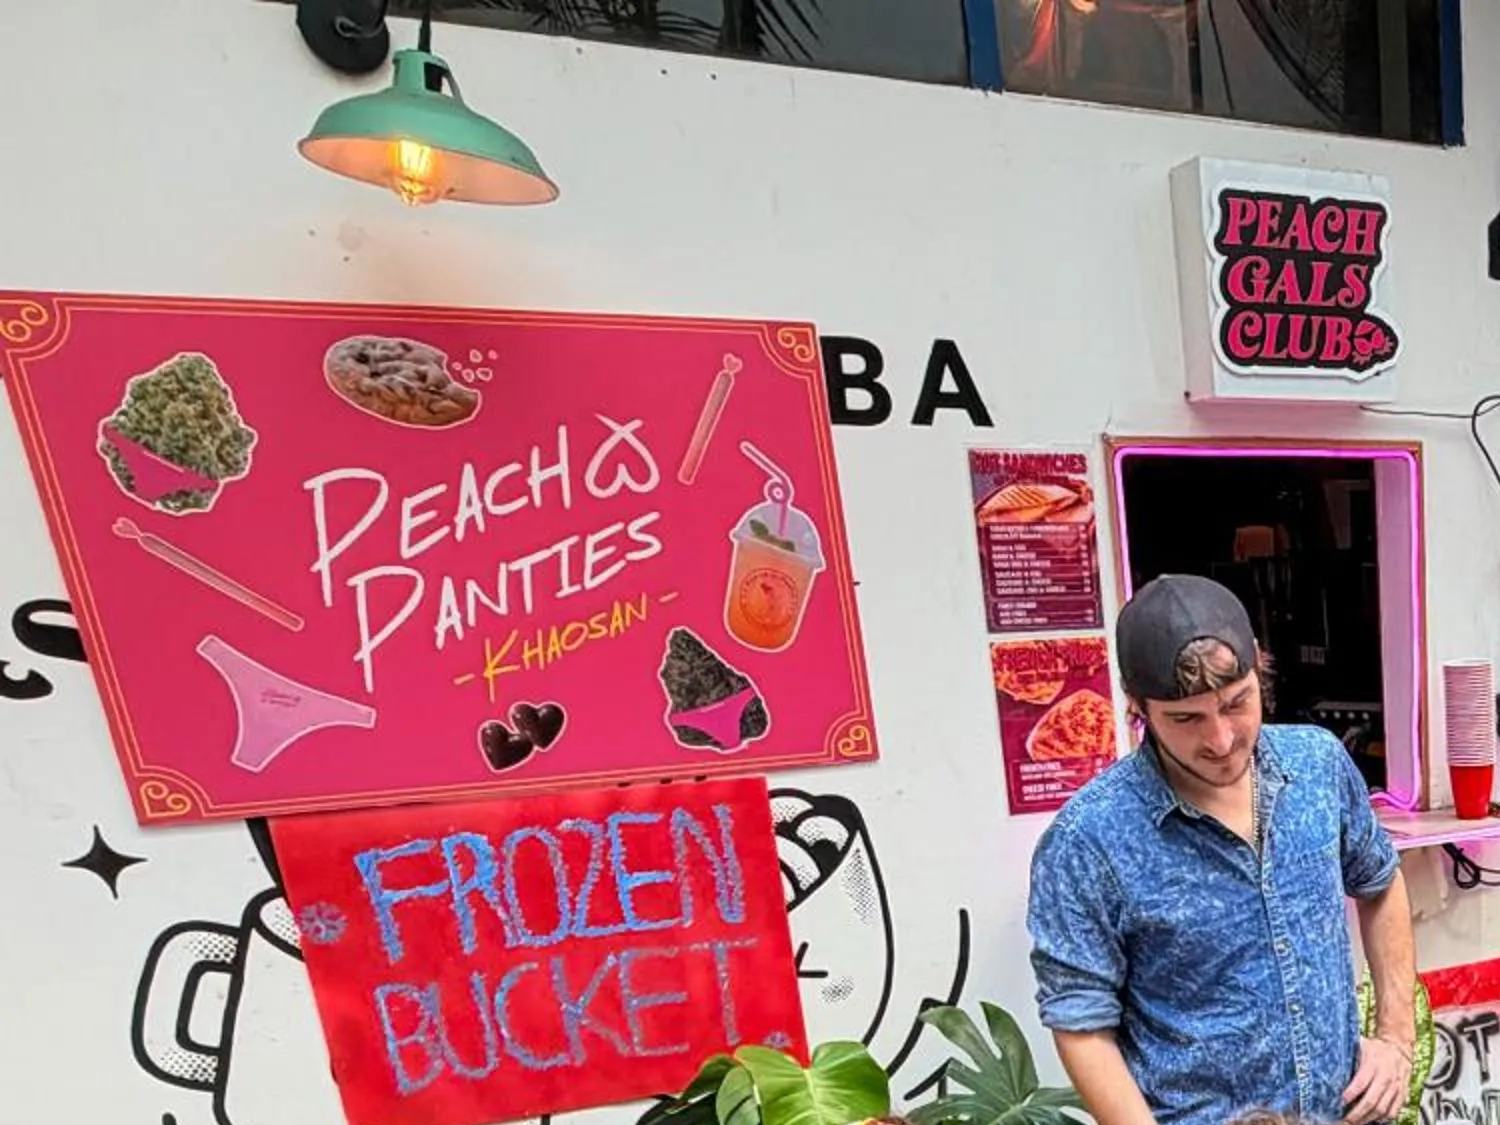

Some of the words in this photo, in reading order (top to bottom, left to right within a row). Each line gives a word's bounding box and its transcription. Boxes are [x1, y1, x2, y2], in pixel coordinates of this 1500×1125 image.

[1221, 197, 1383, 256] PEACH
[1226, 255, 1369, 309] GALS
[1226, 310, 1354, 362] CLUB
[304, 424, 572, 608] PEACH
[346, 511, 664, 693] PANTIES
[353, 803, 745, 965] FROZEN
[374, 937, 761, 1096] BUCKET
